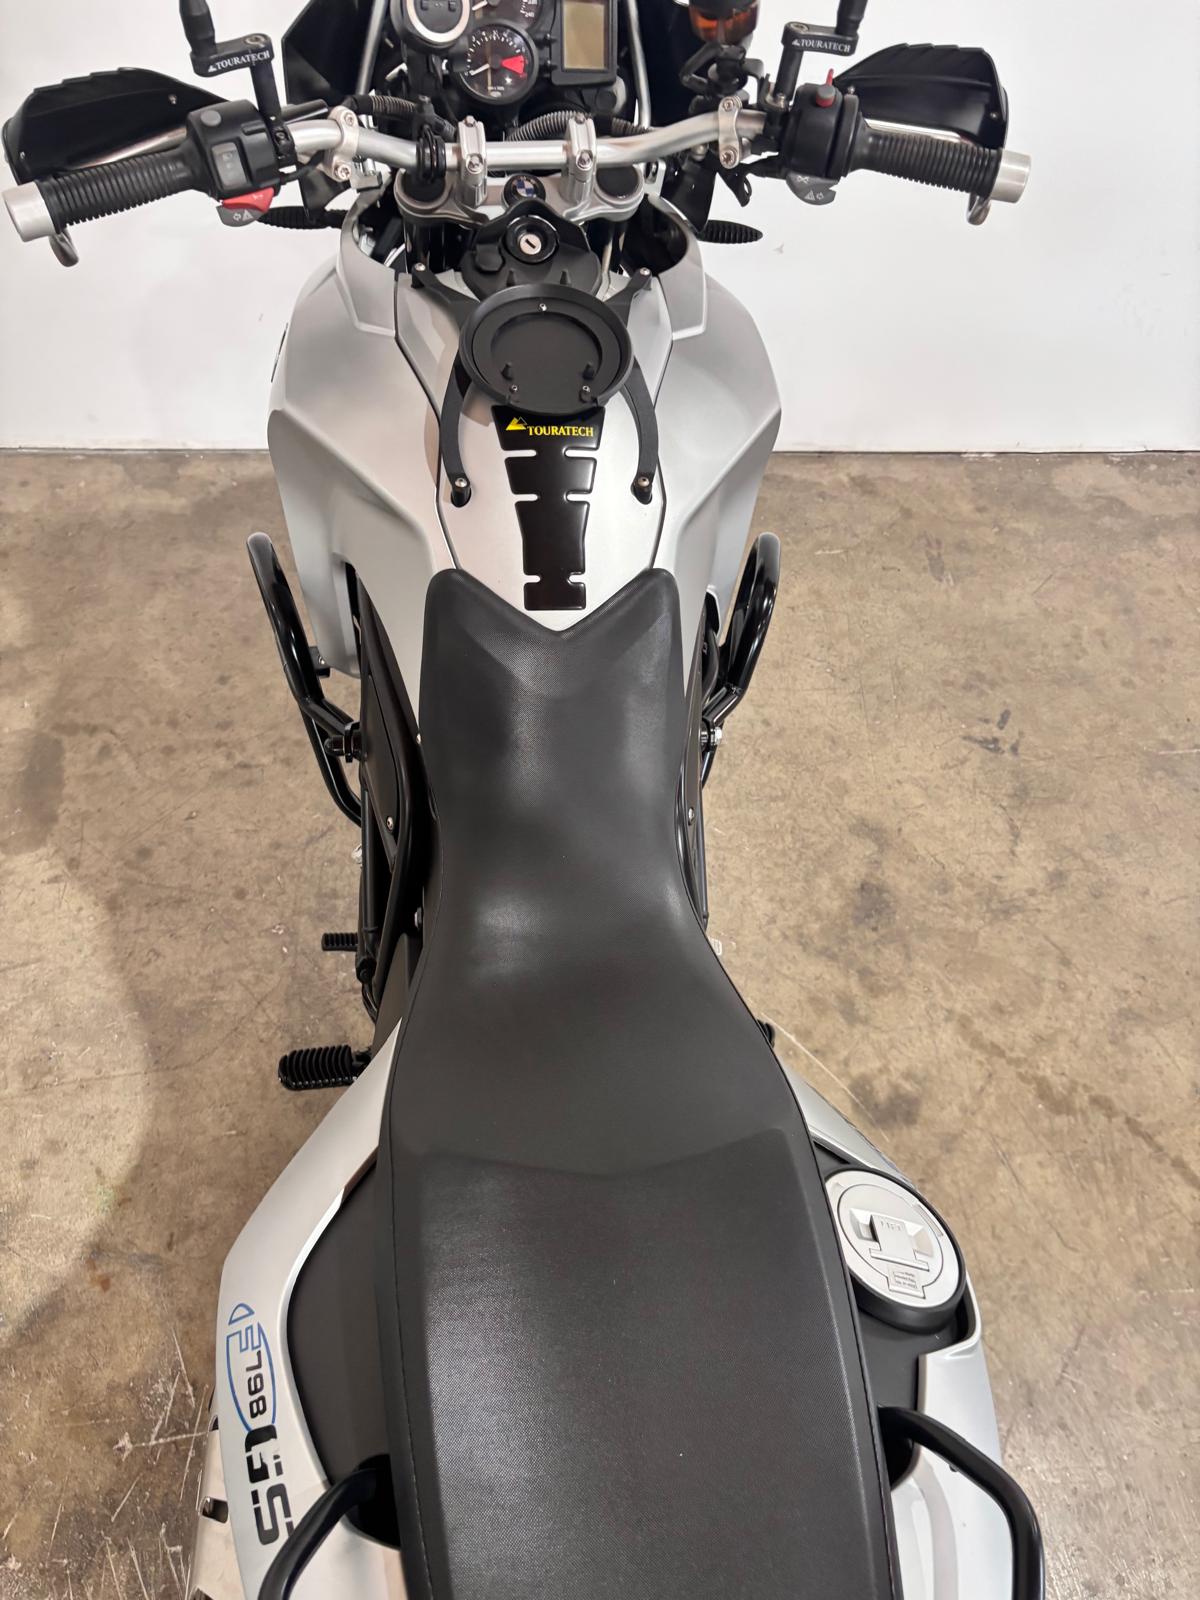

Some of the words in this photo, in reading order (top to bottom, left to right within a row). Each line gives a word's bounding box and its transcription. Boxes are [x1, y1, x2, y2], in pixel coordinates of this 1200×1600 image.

[800, 39, 851, 53] TOURATECH
[216, 50, 270, 70] TOURATECH
[527, 425, 594, 437] TOURATECH
[245, 1350, 267, 1419] 798
